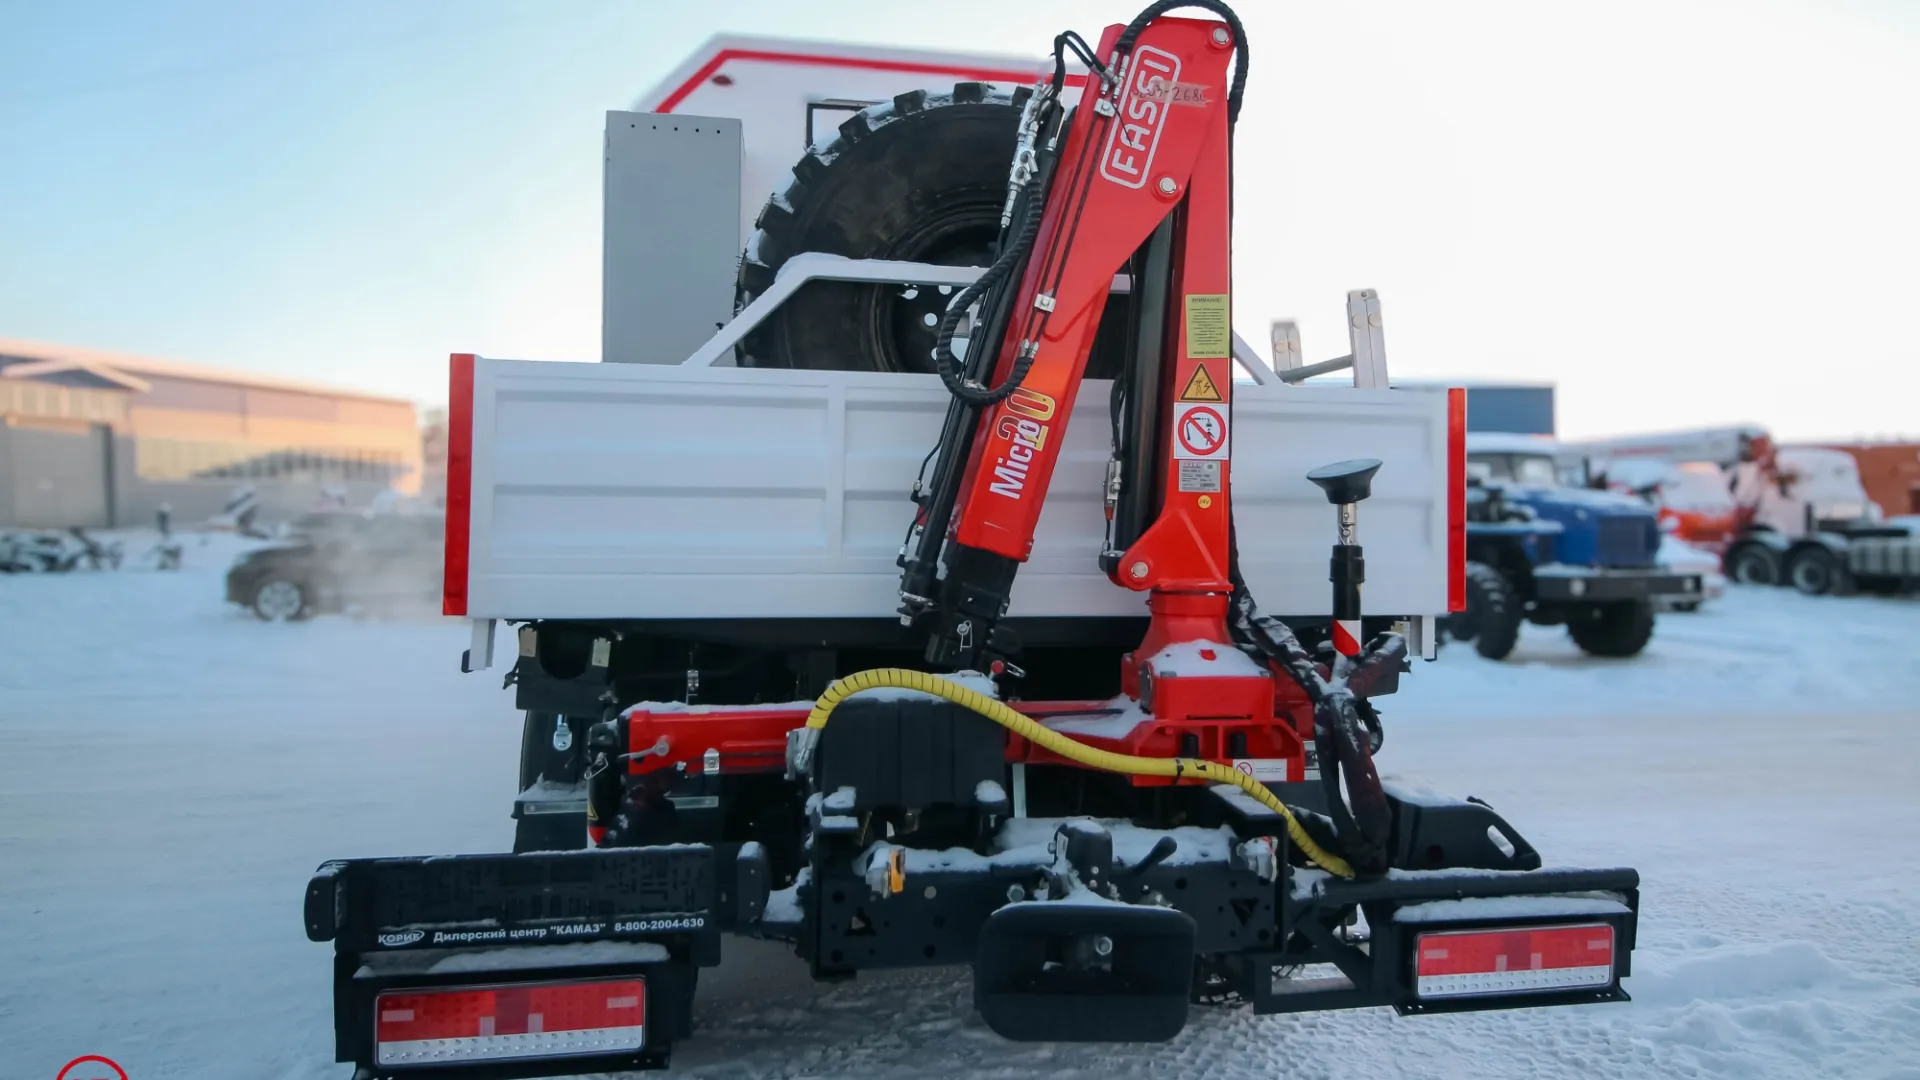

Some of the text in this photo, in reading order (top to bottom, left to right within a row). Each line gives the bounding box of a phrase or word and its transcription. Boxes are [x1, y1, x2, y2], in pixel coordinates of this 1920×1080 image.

[1111, 59, 1170, 175] FASSI
[988, 387, 1056, 499] Micro 20
[433, 929, 506, 944] Дилерский
[510, 928, 547, 938] центр
[550, 922, 606, 935] "КАМАЗ"
[614, 918, 705, 931] 8-800-2004-630
